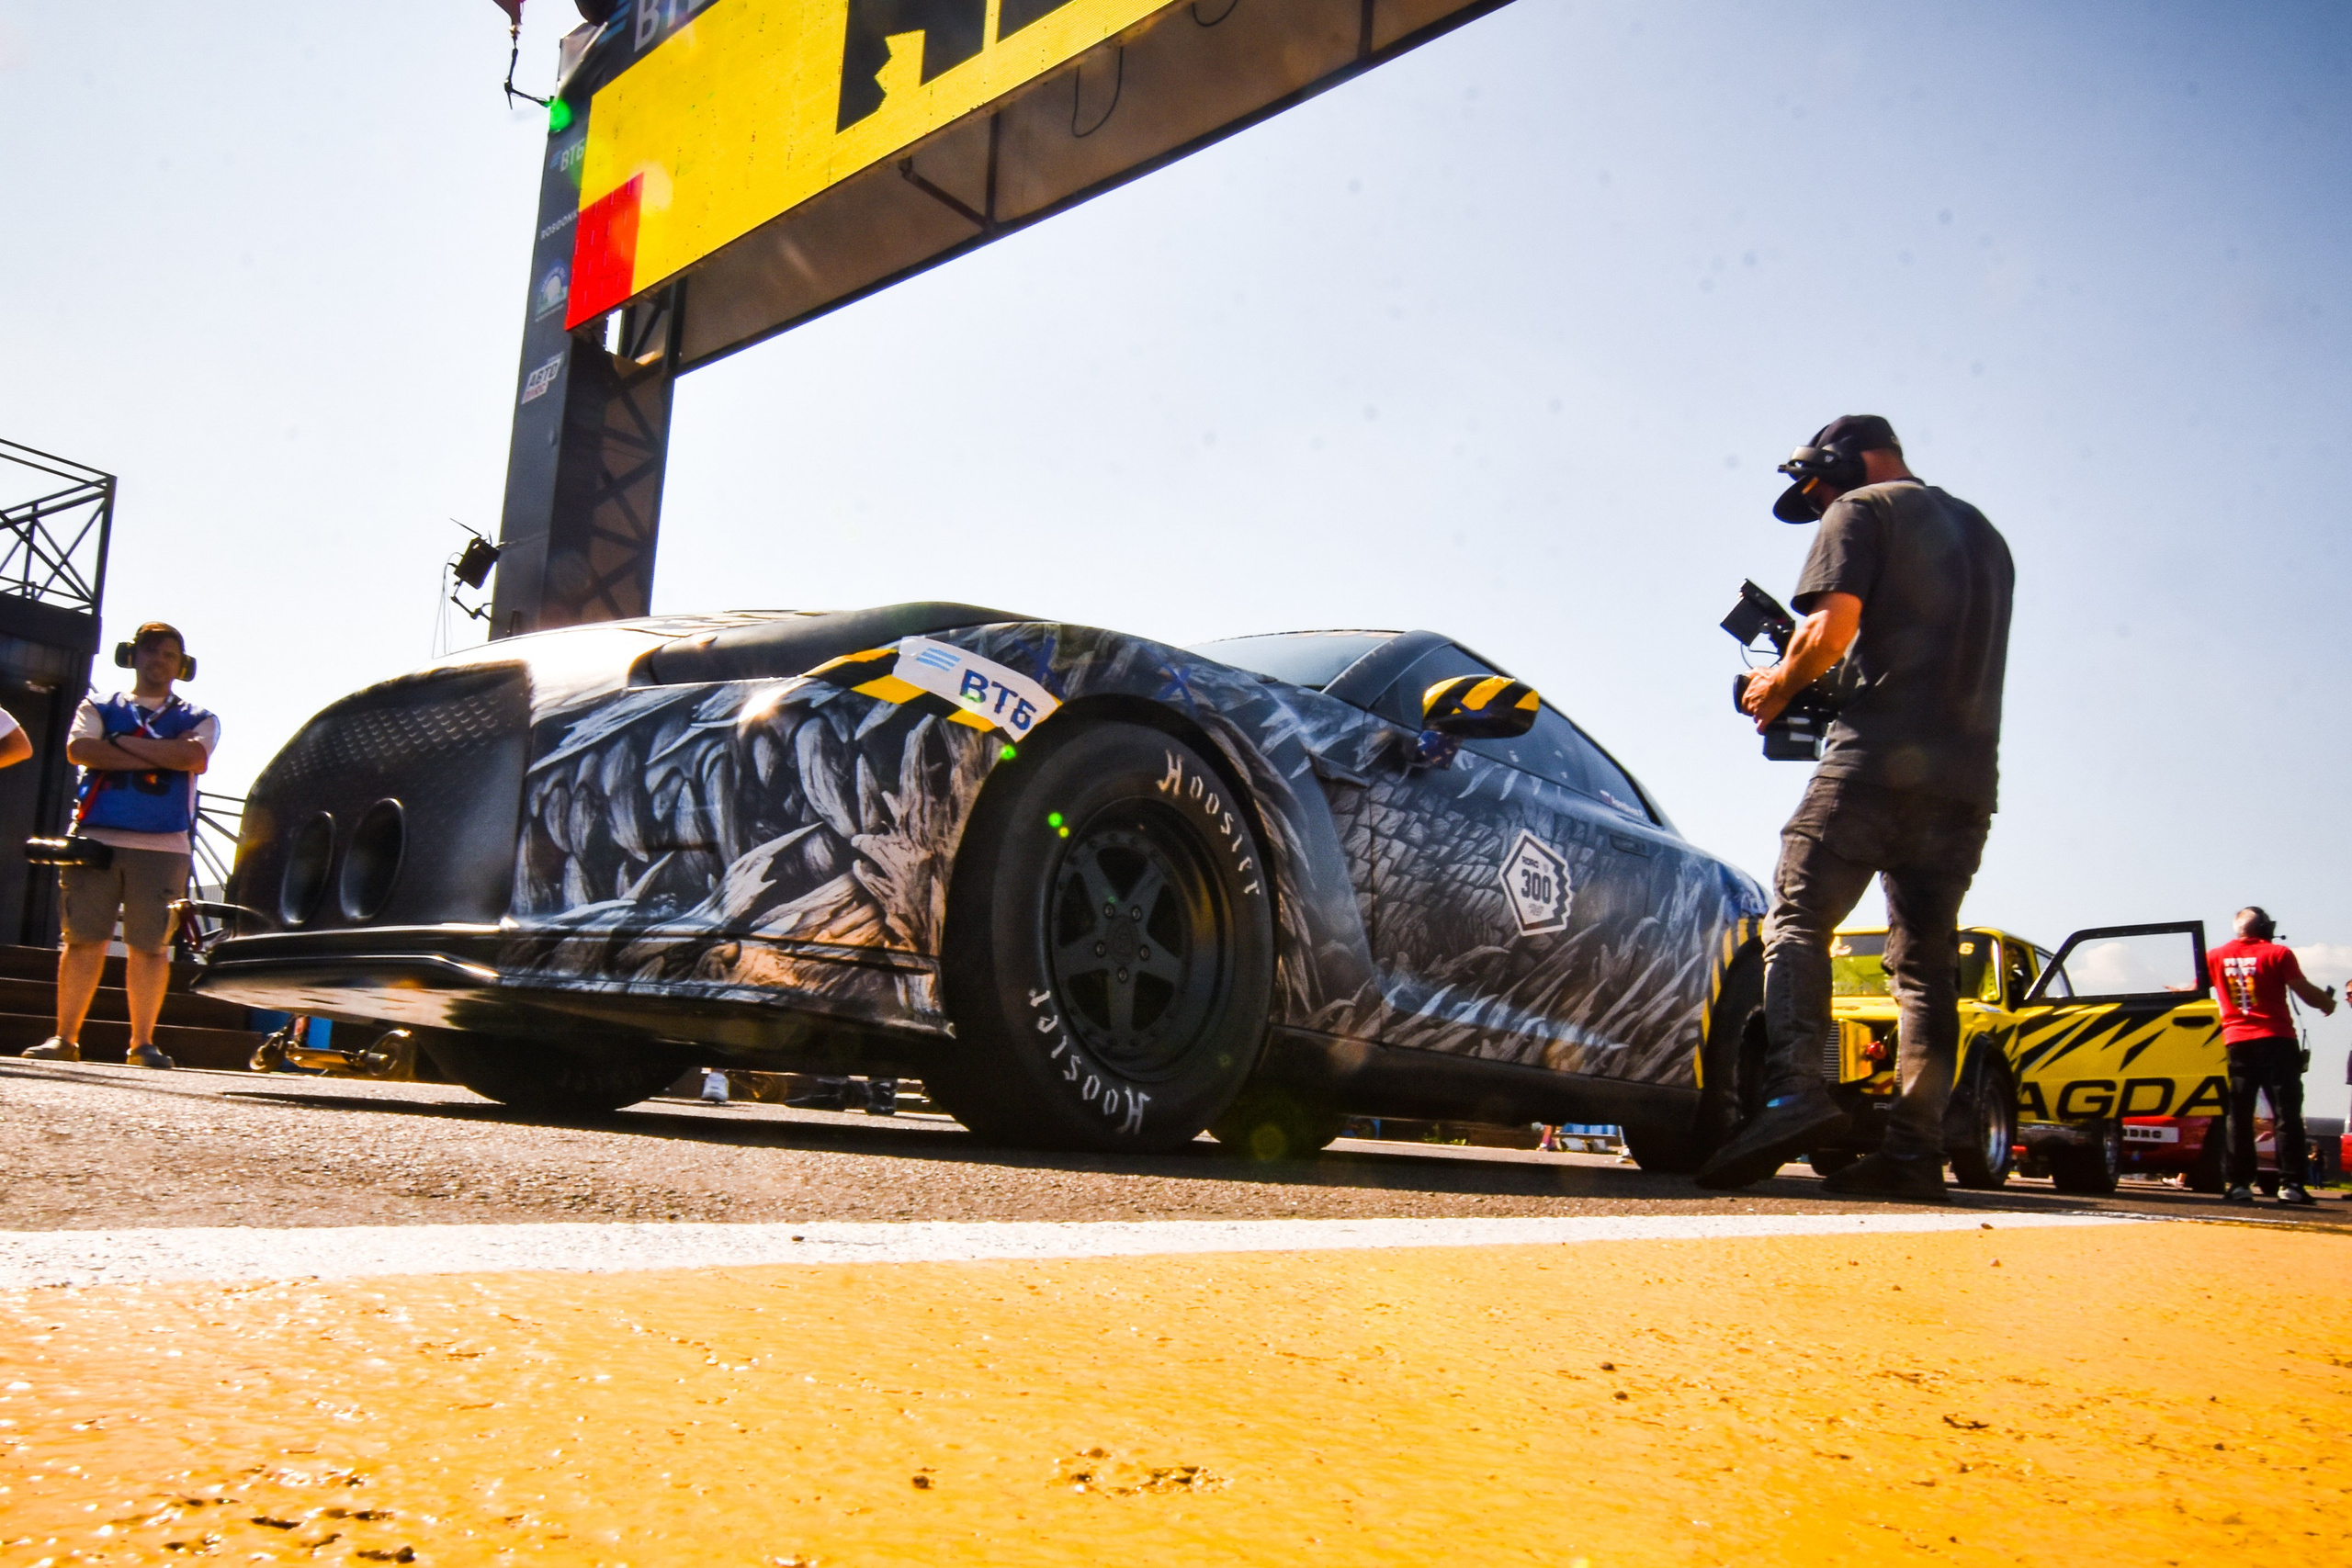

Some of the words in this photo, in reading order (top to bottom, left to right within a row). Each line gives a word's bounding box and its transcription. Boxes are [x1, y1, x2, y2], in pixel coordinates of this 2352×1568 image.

[560, 137, 586, 173] ВТБ
[959, 668, 1037, 731] ВТБ
[1521, 868, 1552, 905] 300
